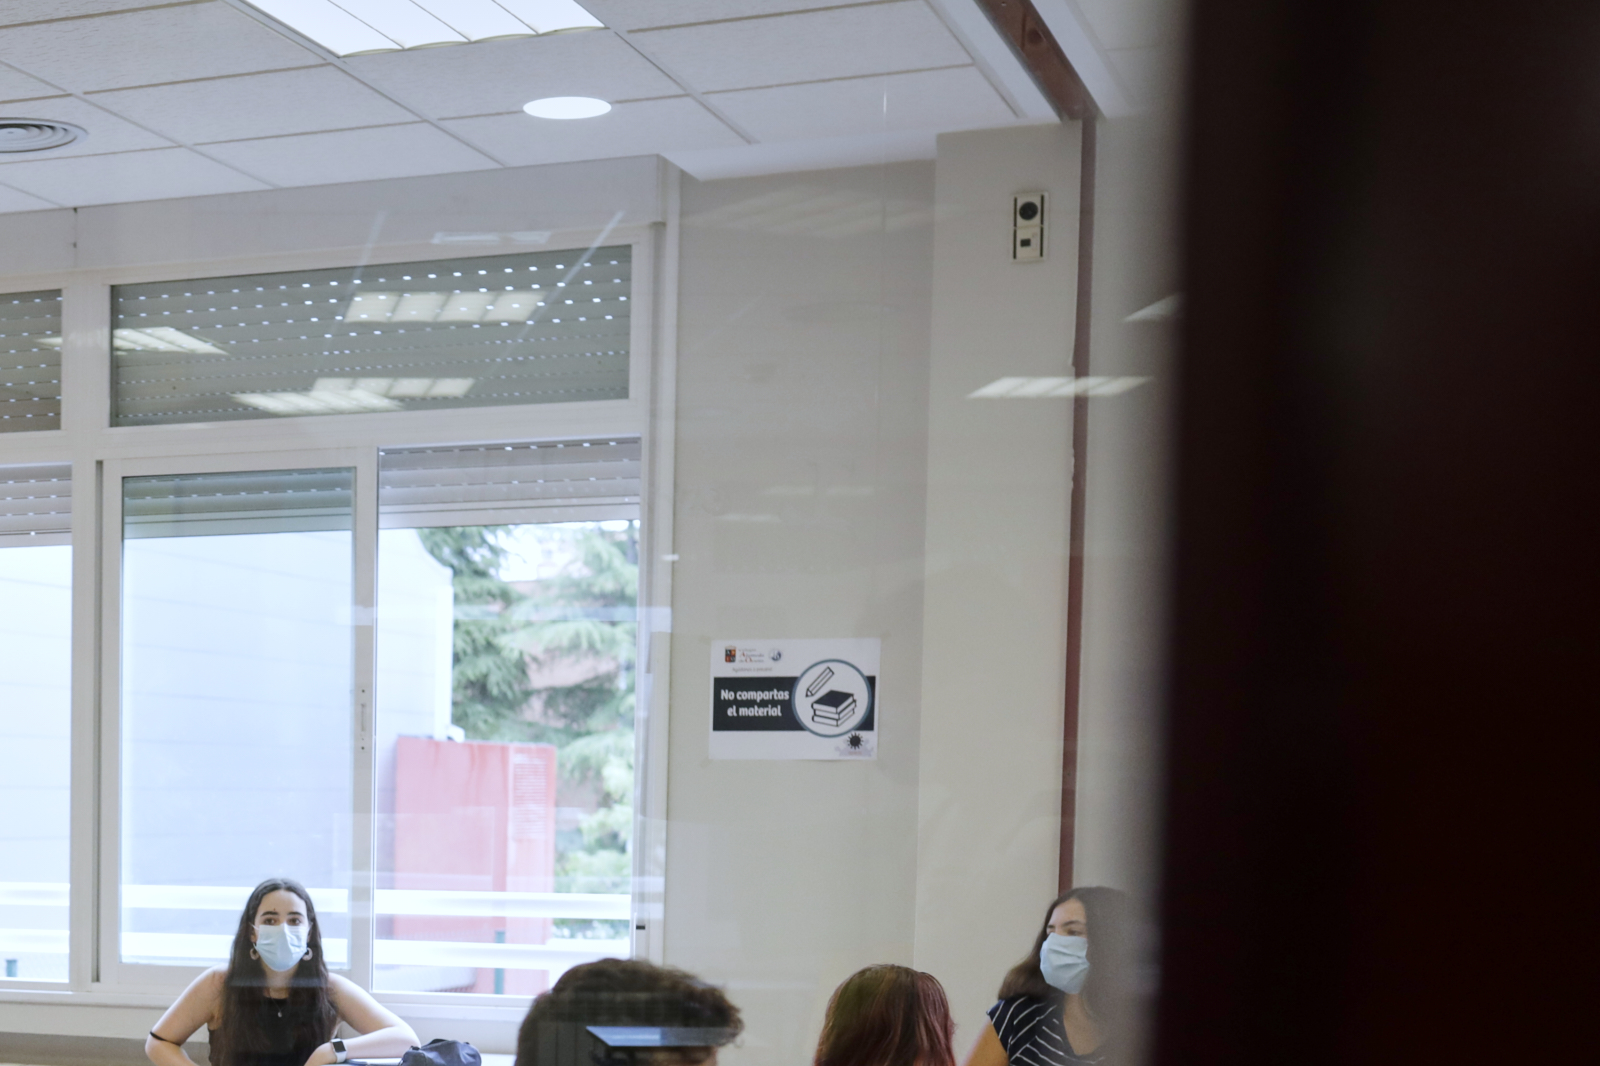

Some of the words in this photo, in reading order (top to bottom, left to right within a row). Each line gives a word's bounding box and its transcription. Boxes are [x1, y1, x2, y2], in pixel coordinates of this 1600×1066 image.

[720, 689, 735, 701] No
[736, 688, 790, 703] compartas
[727, 705, 738, 717] el
[738, 704, 782, 717] material
